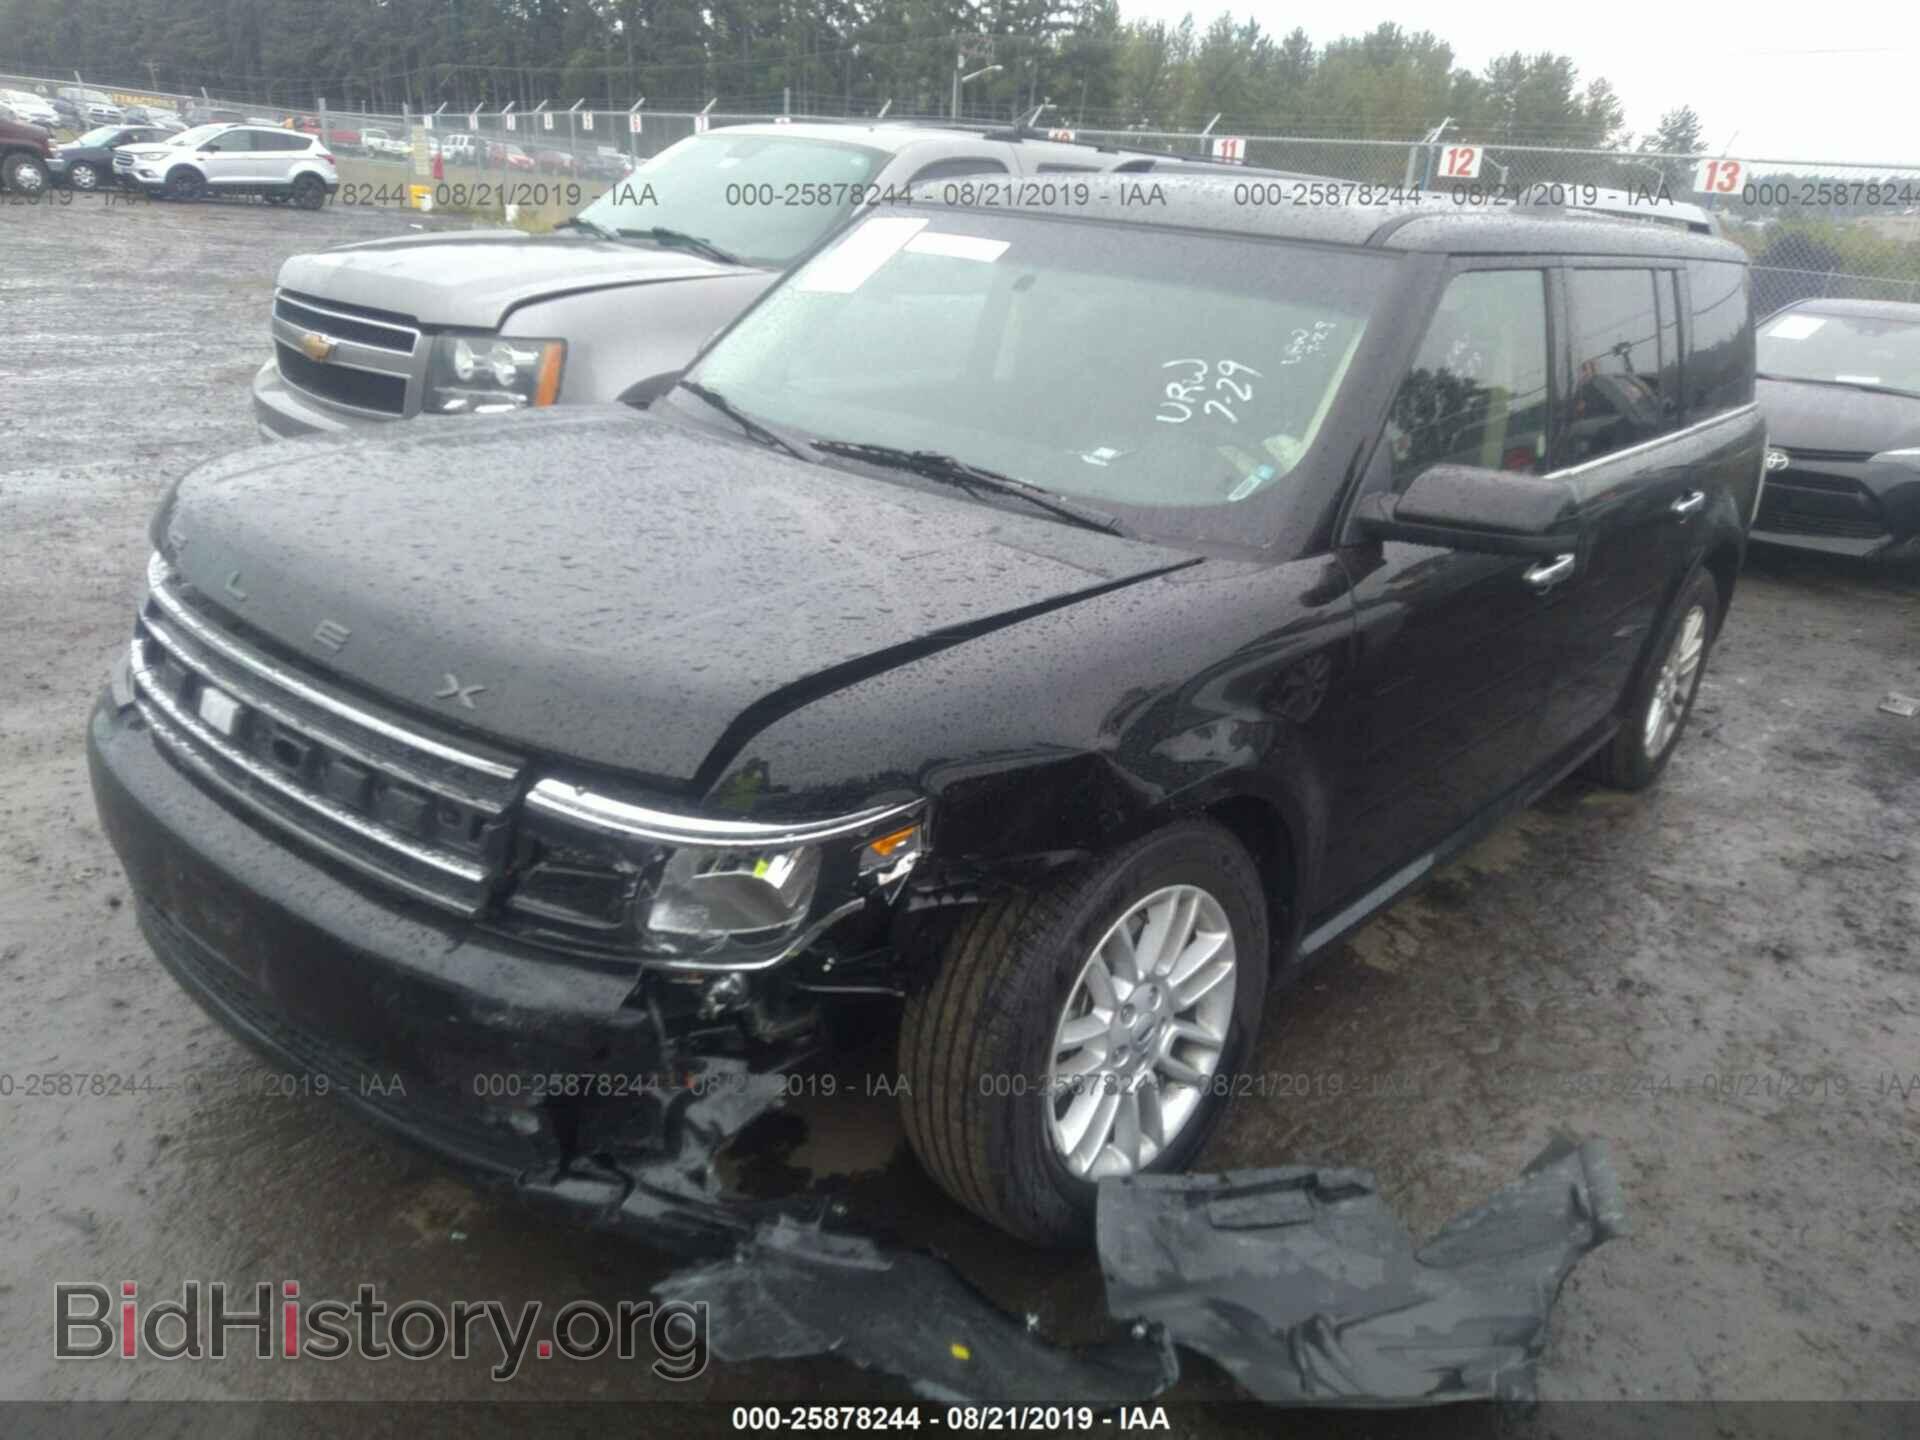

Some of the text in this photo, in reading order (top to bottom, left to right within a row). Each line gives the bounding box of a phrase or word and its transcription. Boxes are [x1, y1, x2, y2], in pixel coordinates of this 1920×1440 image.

[1221, 141, 1237, 160] 11
[1448, 148, 1474, 176] 12
[1705, 160, 1740, 192] 13
